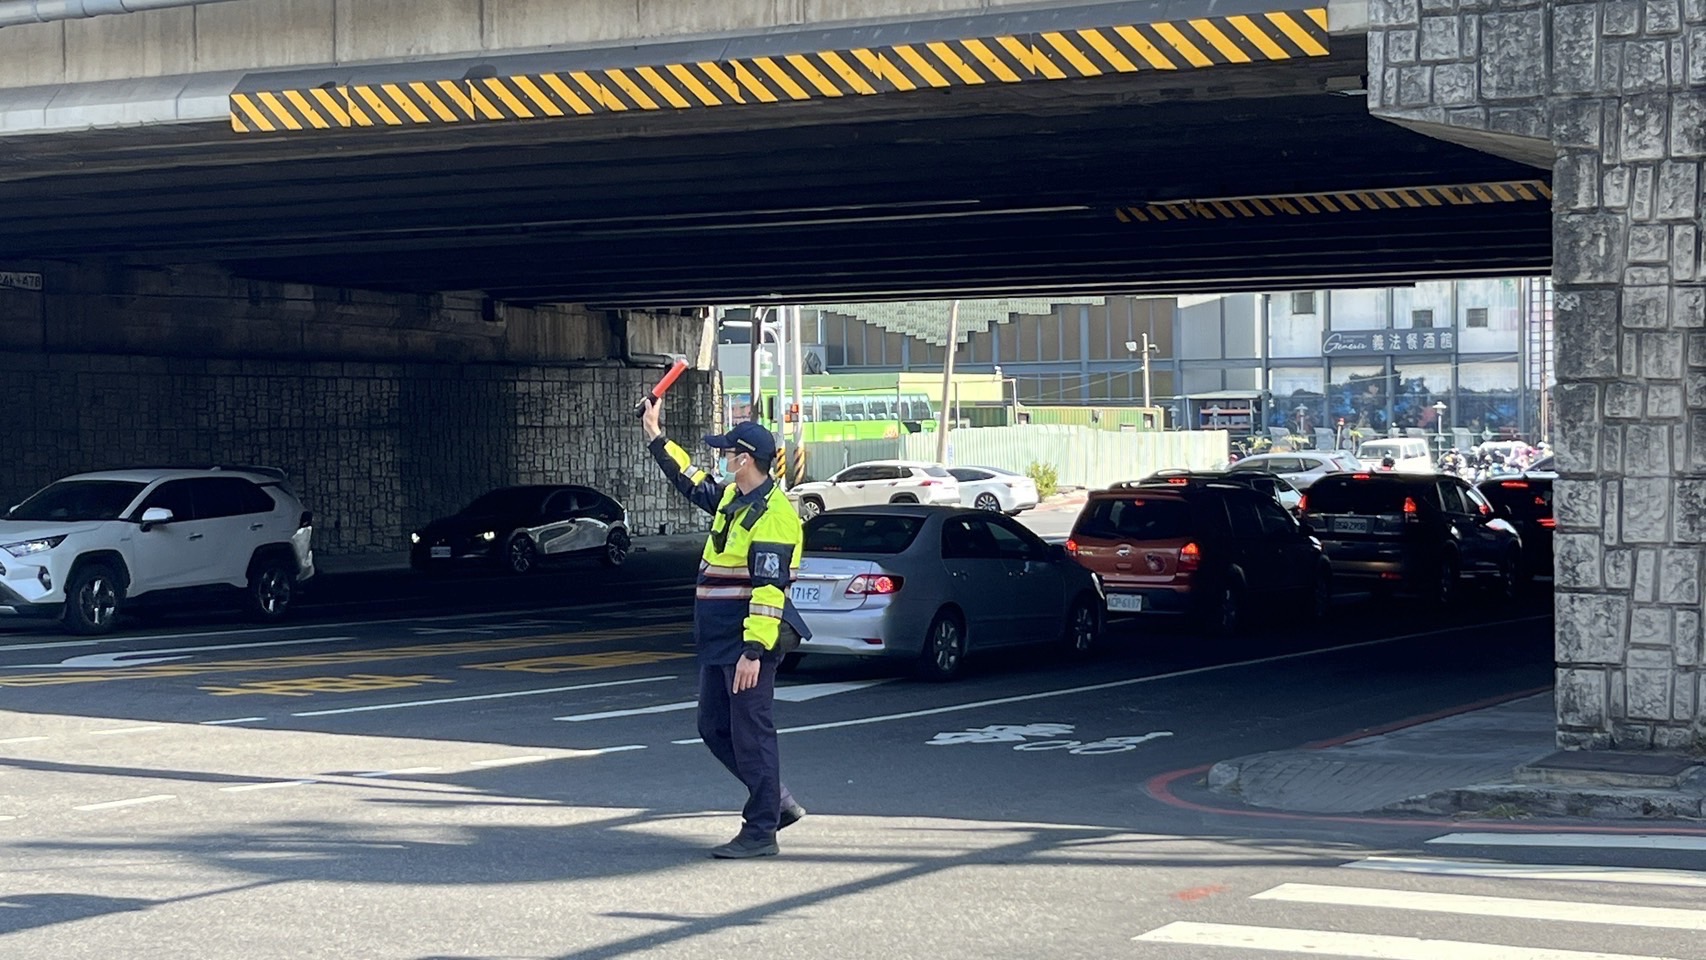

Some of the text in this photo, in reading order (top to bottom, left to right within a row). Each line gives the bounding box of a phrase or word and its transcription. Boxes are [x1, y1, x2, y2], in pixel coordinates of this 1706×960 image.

[1372, 332, 1453, 351] 義法餐酒館
[791, 587, 820, 600] 171-F2
